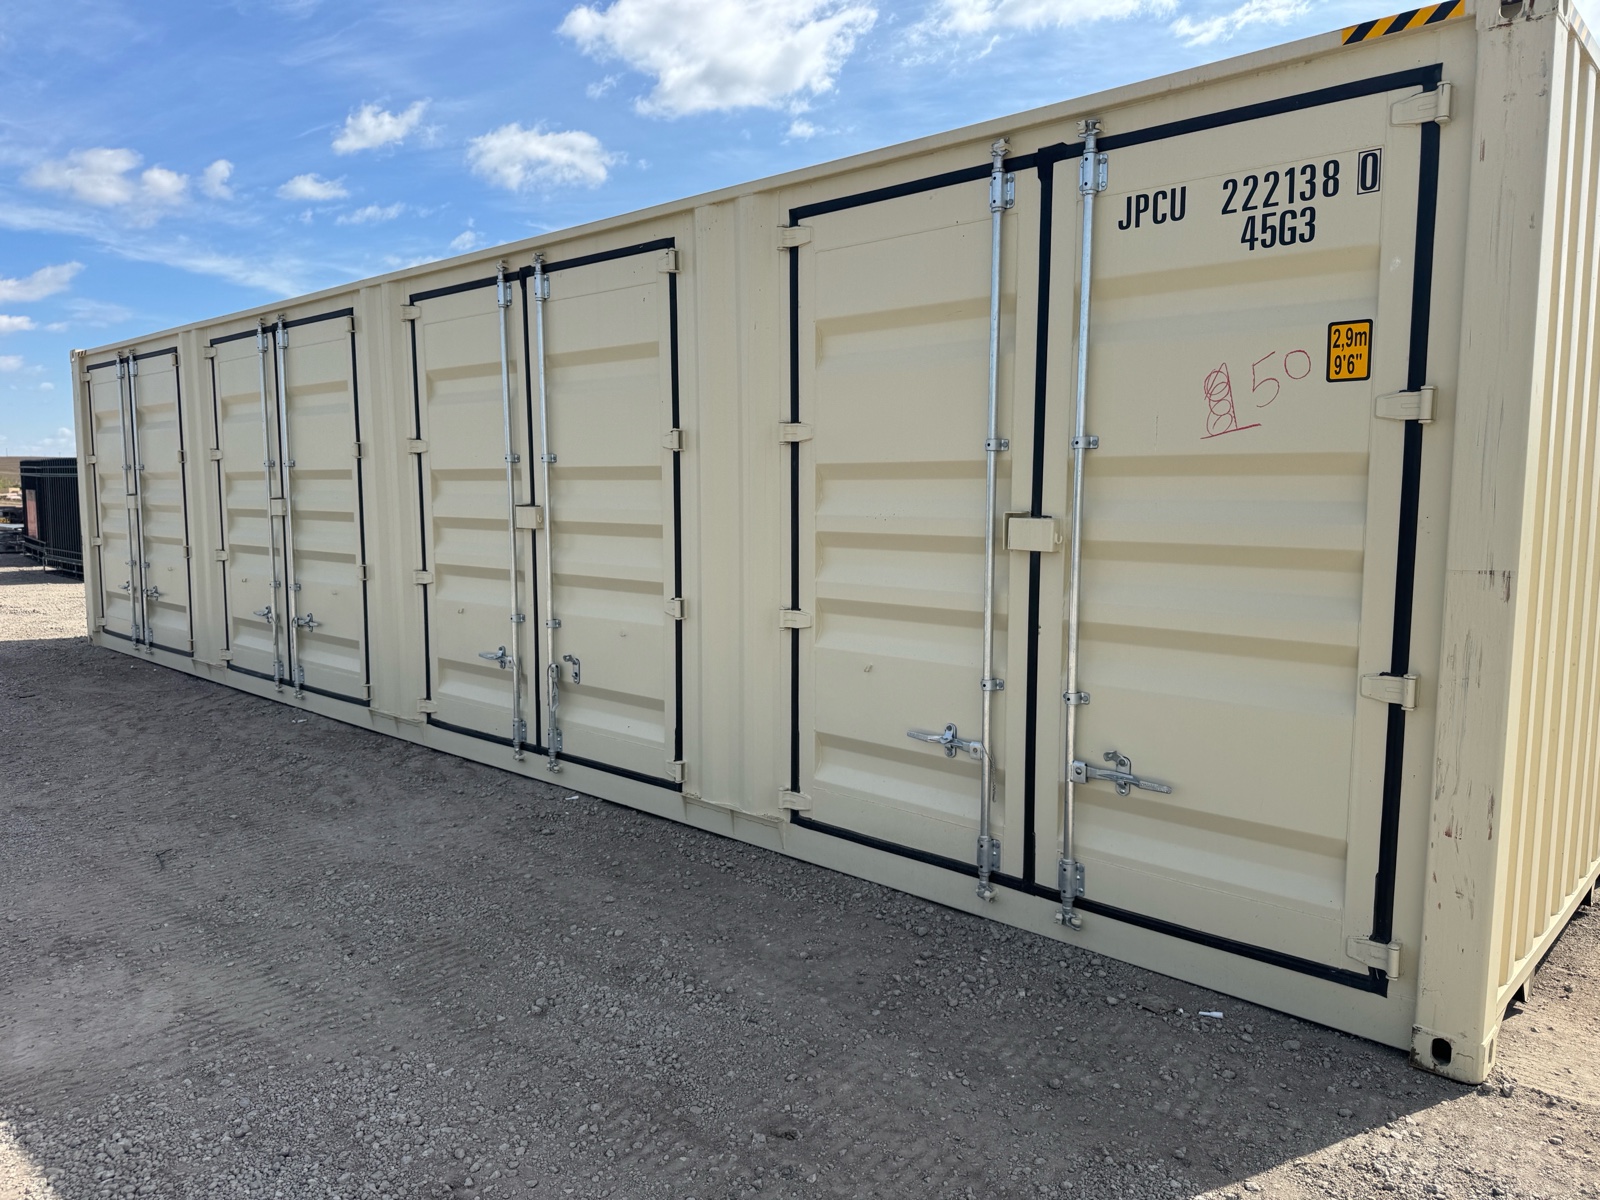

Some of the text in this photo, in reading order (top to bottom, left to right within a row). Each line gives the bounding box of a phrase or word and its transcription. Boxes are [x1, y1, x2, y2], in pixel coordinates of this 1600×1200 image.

[1118, 152, 1379, 231] JPCU 222138 0
[1240, 206, 1316, 251] 45G3
[1332, 327, 1367, 351] 2,9m
[1334, 353, 1362, 375] 9'6"
